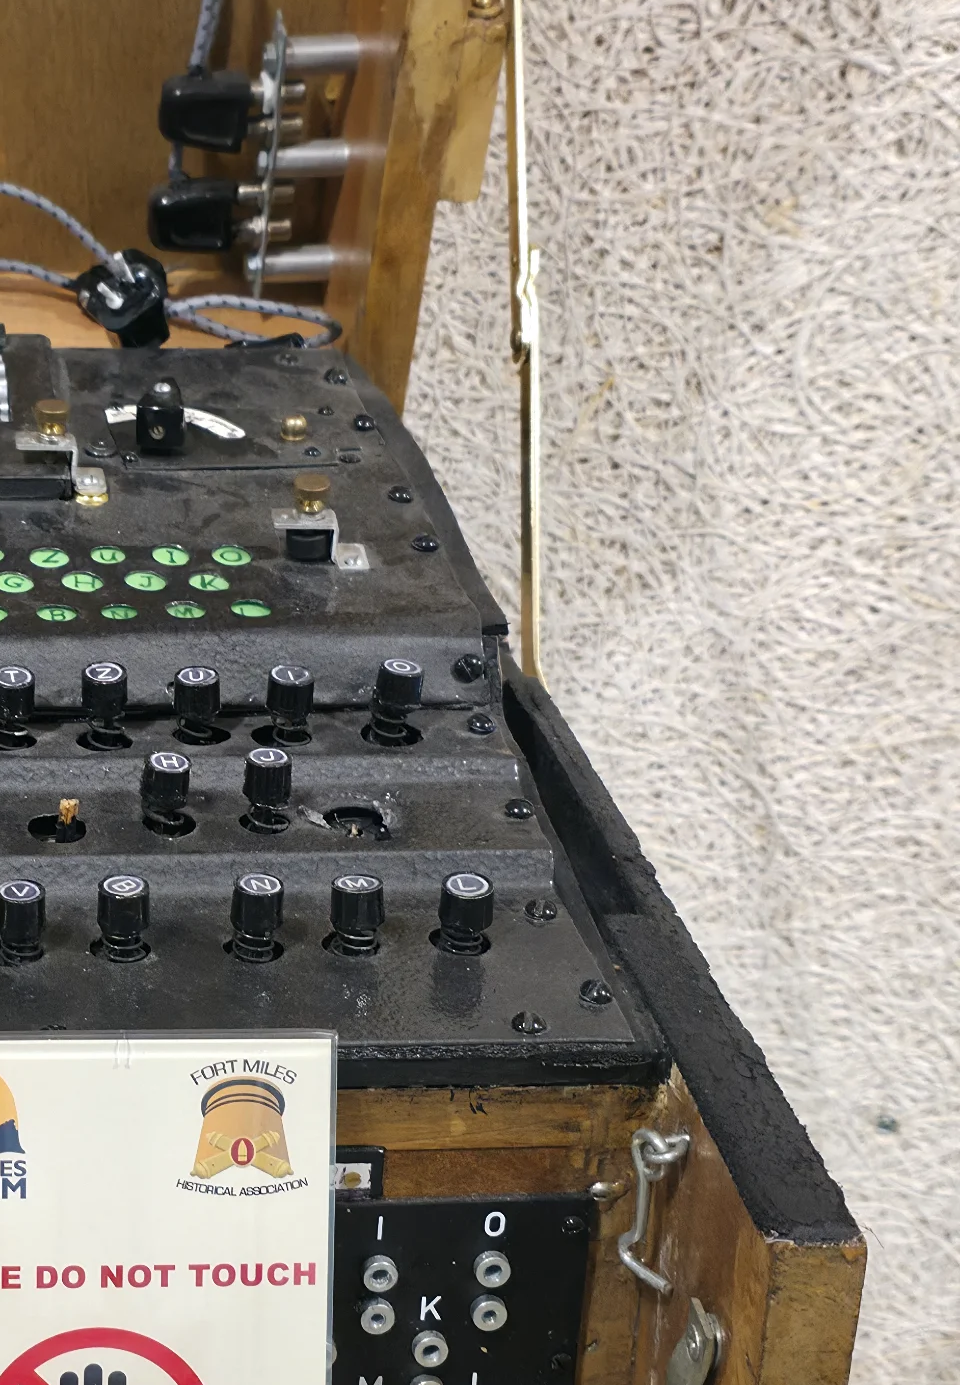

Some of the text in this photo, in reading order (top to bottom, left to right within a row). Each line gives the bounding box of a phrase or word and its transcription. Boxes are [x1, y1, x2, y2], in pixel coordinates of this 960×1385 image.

[41, 550, 60, 564] Z
[99, 551, 118, 562] U
[219, 550, 243, 562] O
[3, 575, 25, 588] G
[74, 575, 96, 590] H
[139, 574, 153, 588] J
[200, 575, 221, 590] K
[3, 670, 18, 683] T
[96, 667, 112, 679] Z
[189, 671, 203, 682] U
[394, 661, 412, 672] O
[160, 756, 179, 768] H
[259, 751, 275, 762] J
[10, 885, 30, 897] V
[112, 880, 136, 892] B
[248, 878, 271, 890] N
[344, 877, 368, 889] M
[459, 878, 477, 890] L
[190, 1059, 297, 1085] FORT MILES
[176, 1177, 309, 1197] HISTORICAL ASSOCIATION
[376, 1216, 384, 1240] I
[484, 1211, 506, 1237] O
[36, 1264, 86, 1289] DO
[100, 1264, 175, 1288] NOT
[189, 1262, 317, 1287] TOUCH
[419, 1295, 442, 1321] K
